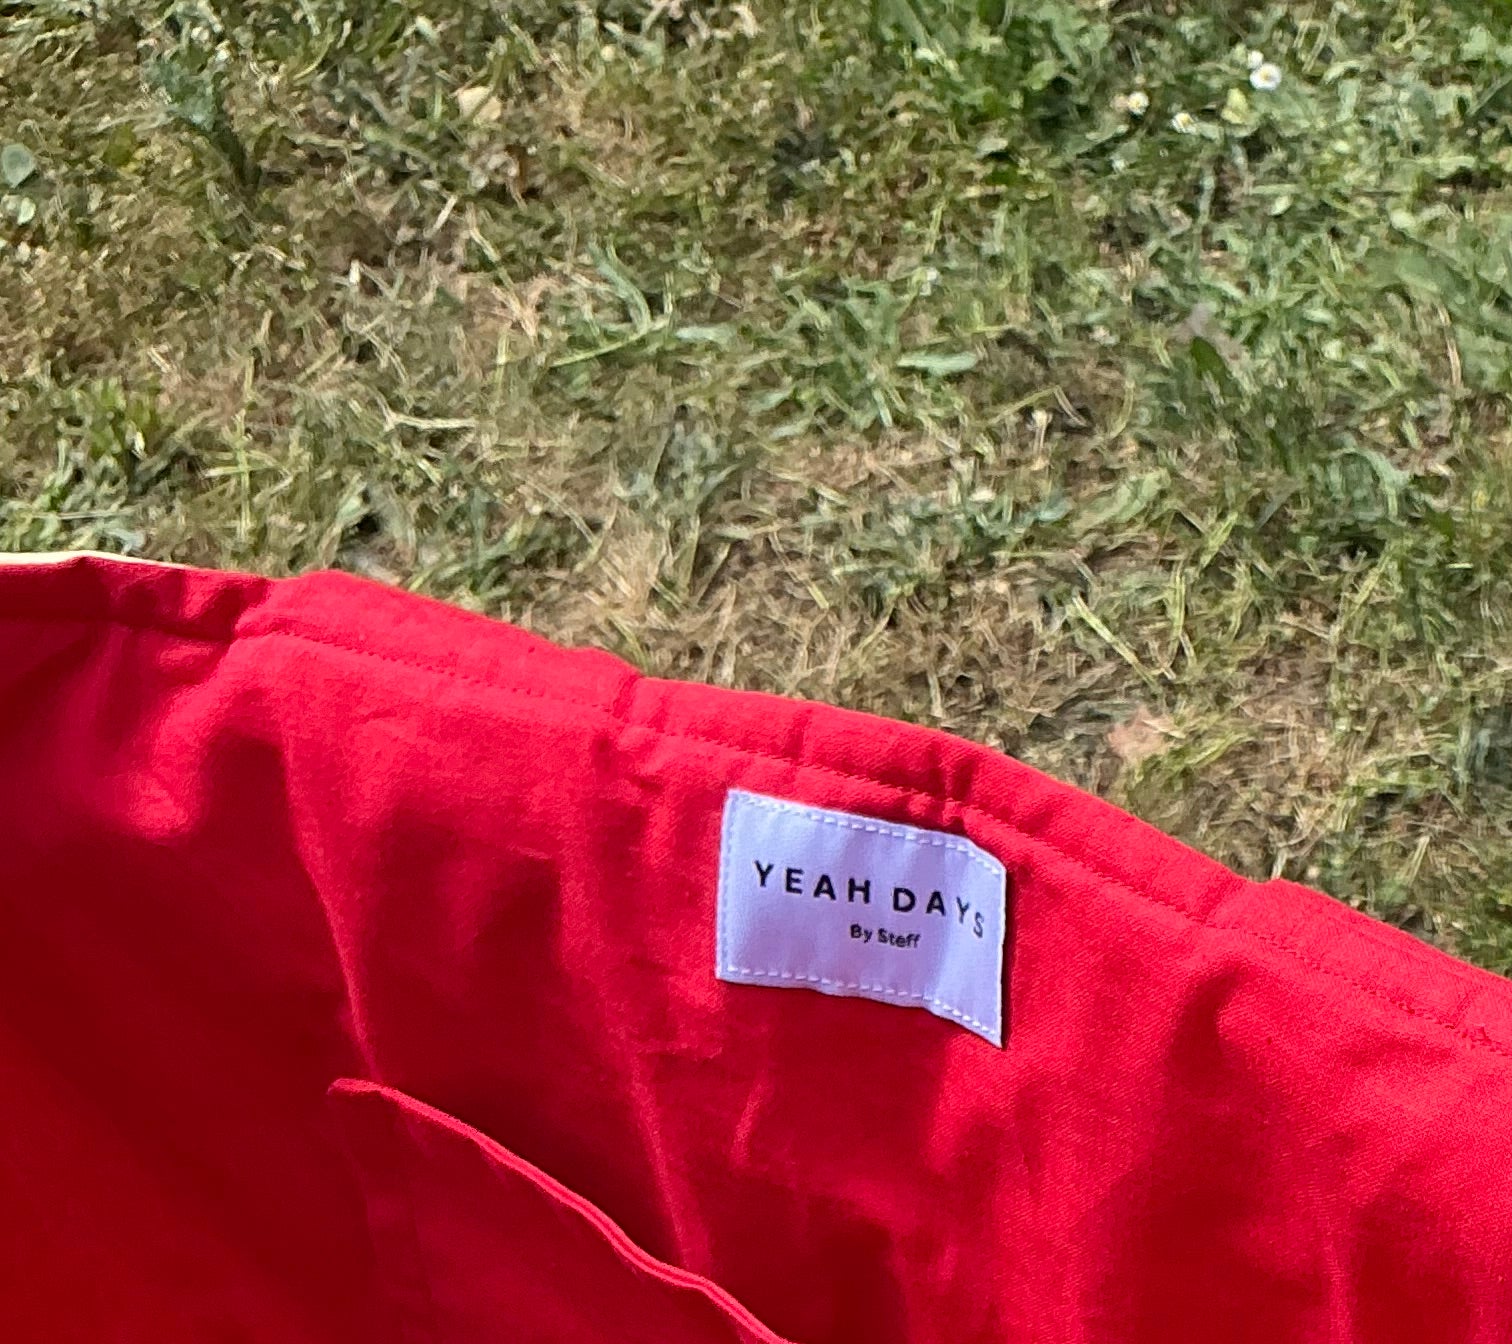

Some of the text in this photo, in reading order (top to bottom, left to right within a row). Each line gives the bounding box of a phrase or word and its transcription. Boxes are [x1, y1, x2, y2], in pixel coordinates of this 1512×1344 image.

[754, 860, 985, 938] YEAH DAYS
[850, 923, 922, 949] By Steff
